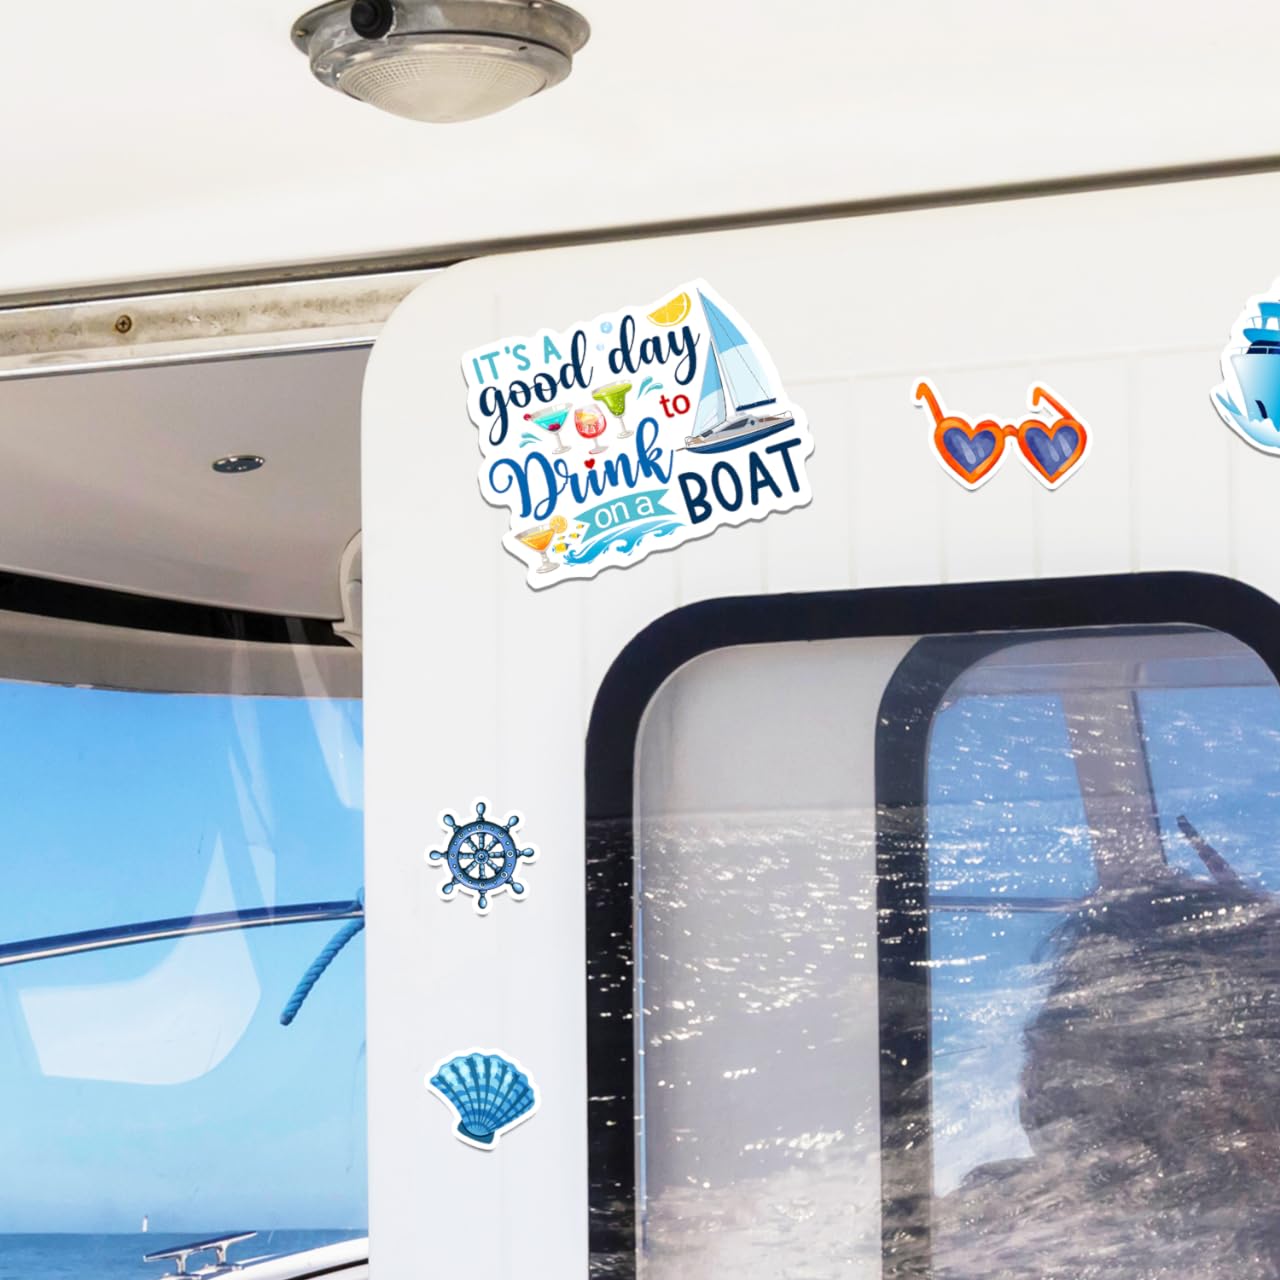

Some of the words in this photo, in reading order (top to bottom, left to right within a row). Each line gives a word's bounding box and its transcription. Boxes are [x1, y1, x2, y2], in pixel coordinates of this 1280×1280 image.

[473, 344, 531, 384] IT'S
[544, 336, 562, 363] A
[479, 330, 593, 446] good
[608, 315, 700, 385] day
[659, 394, 690, 418] to
[489, 417, 674, 520] Drink
[678, 438, 802, 524] BOAT
[594, 501, 630, 529] on
[635, 496, 655, 515] a
